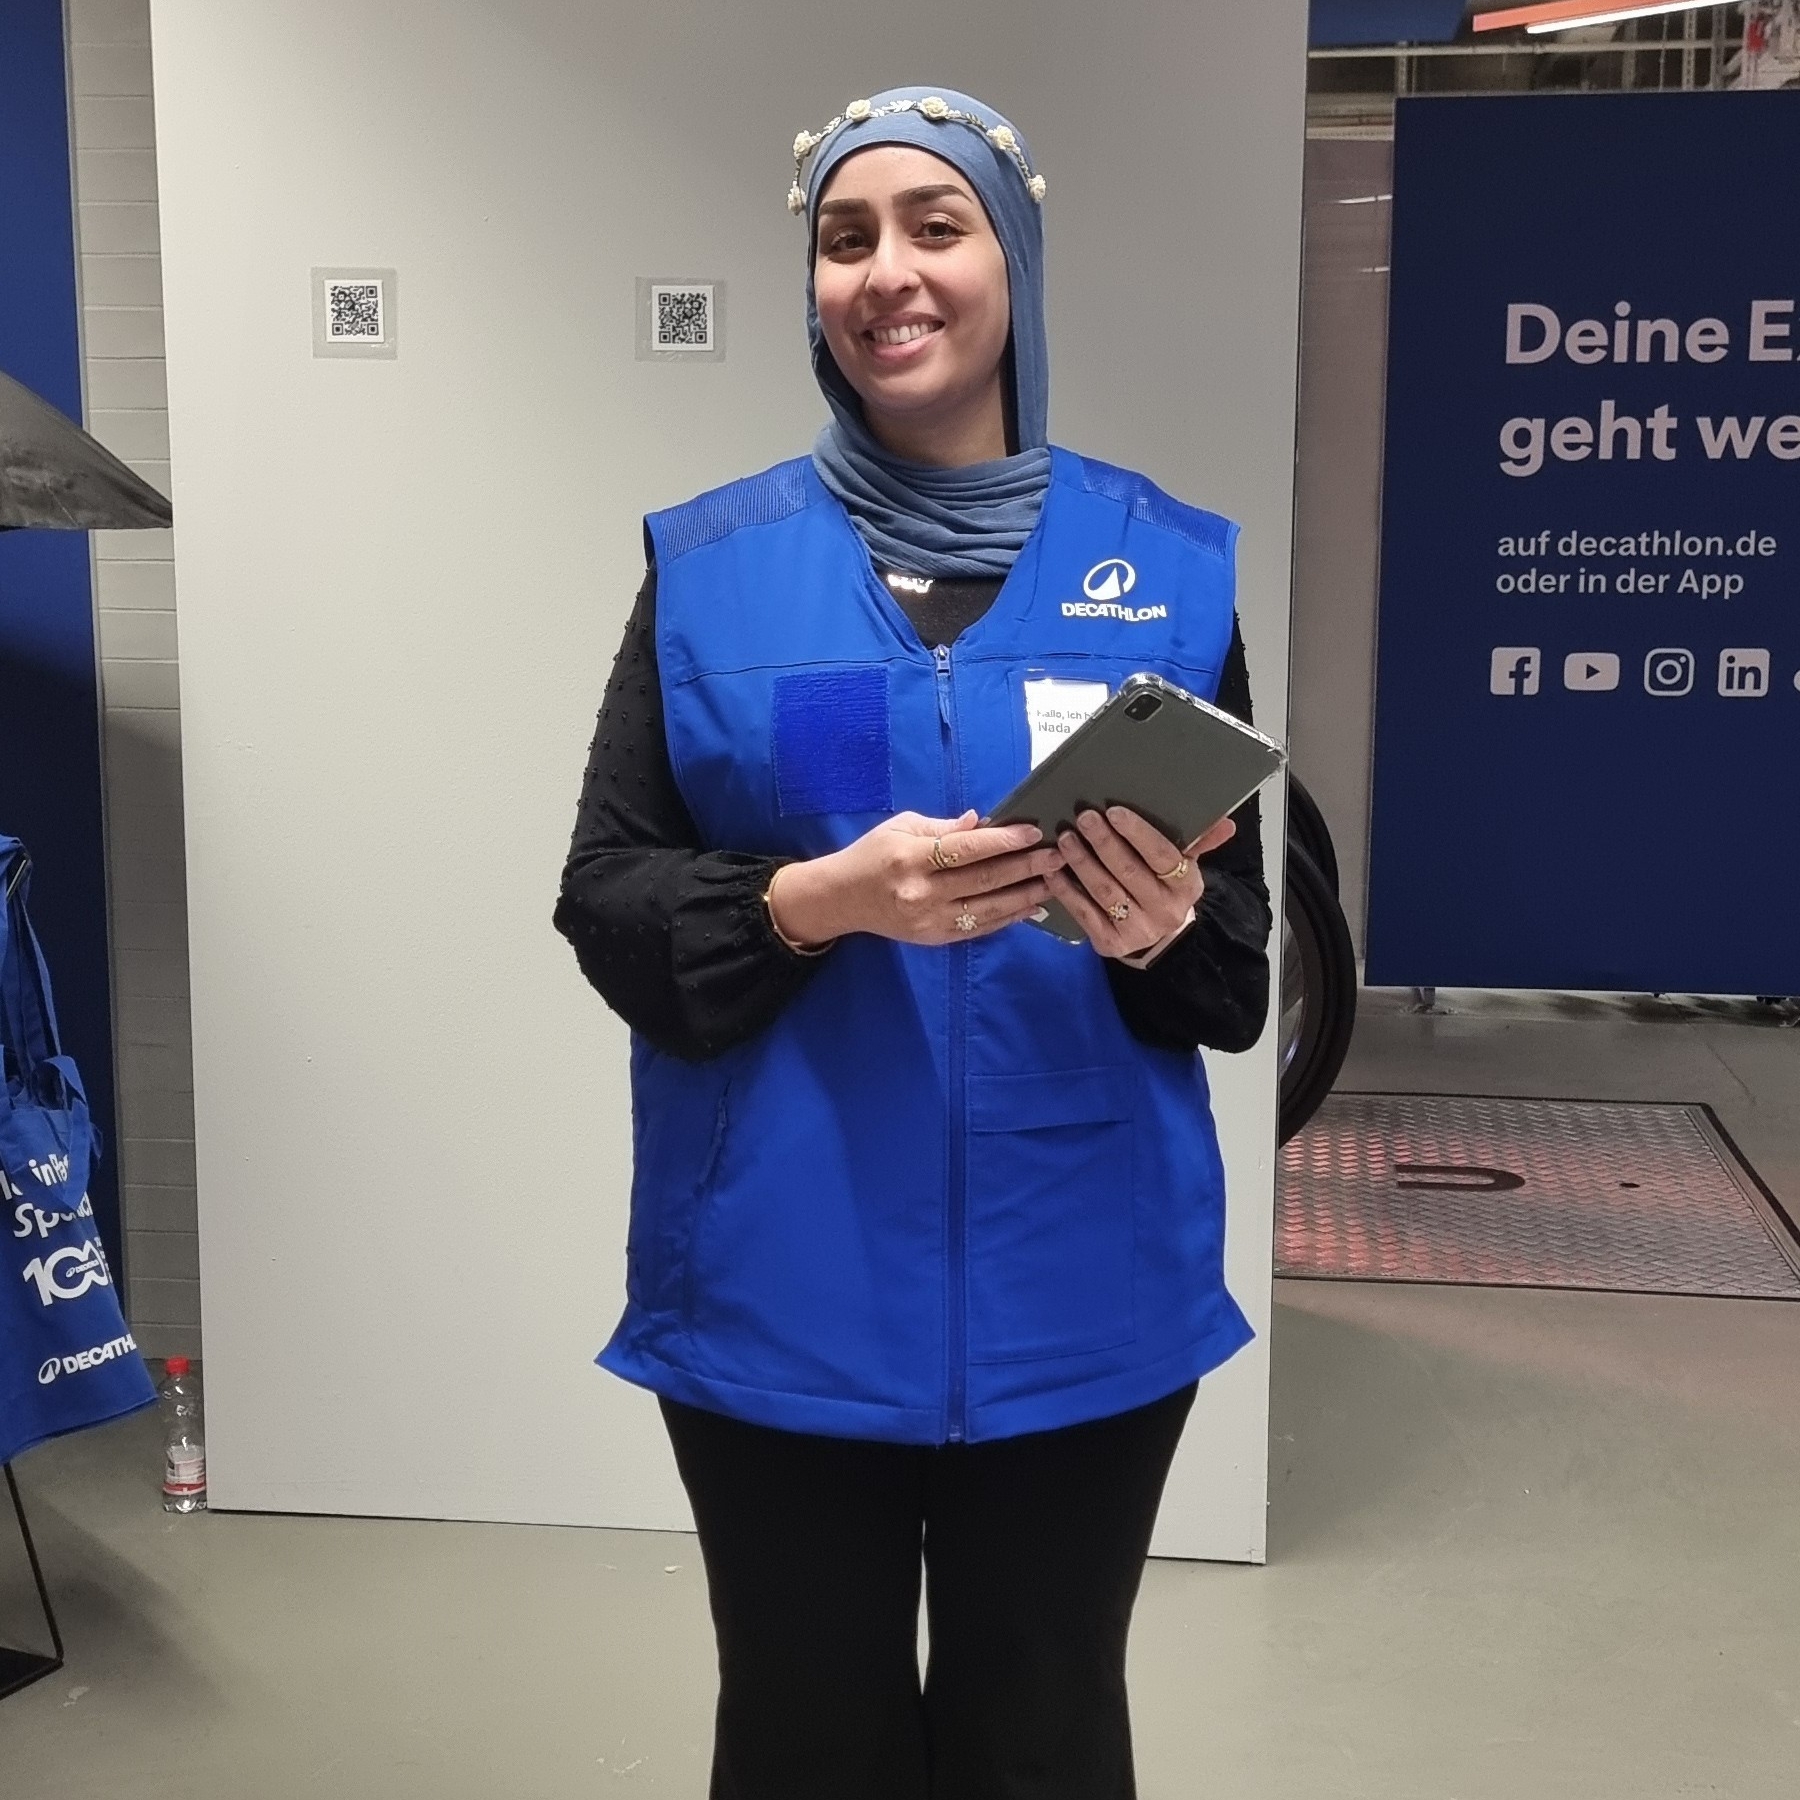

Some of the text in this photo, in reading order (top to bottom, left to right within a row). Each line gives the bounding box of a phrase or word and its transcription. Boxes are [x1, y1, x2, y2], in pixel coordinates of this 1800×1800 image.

[1505, 300, 1800, 365] Deine E
[1499, 399, 1800, 478] geht we
[1497, 529, 1777, 557] auf decathlon.de
[1495, 567, 1745, 600] oder in der App
[1061, 602, 1168, 623] DECATHLON
[1038, 721, 1071, 734] Nada
